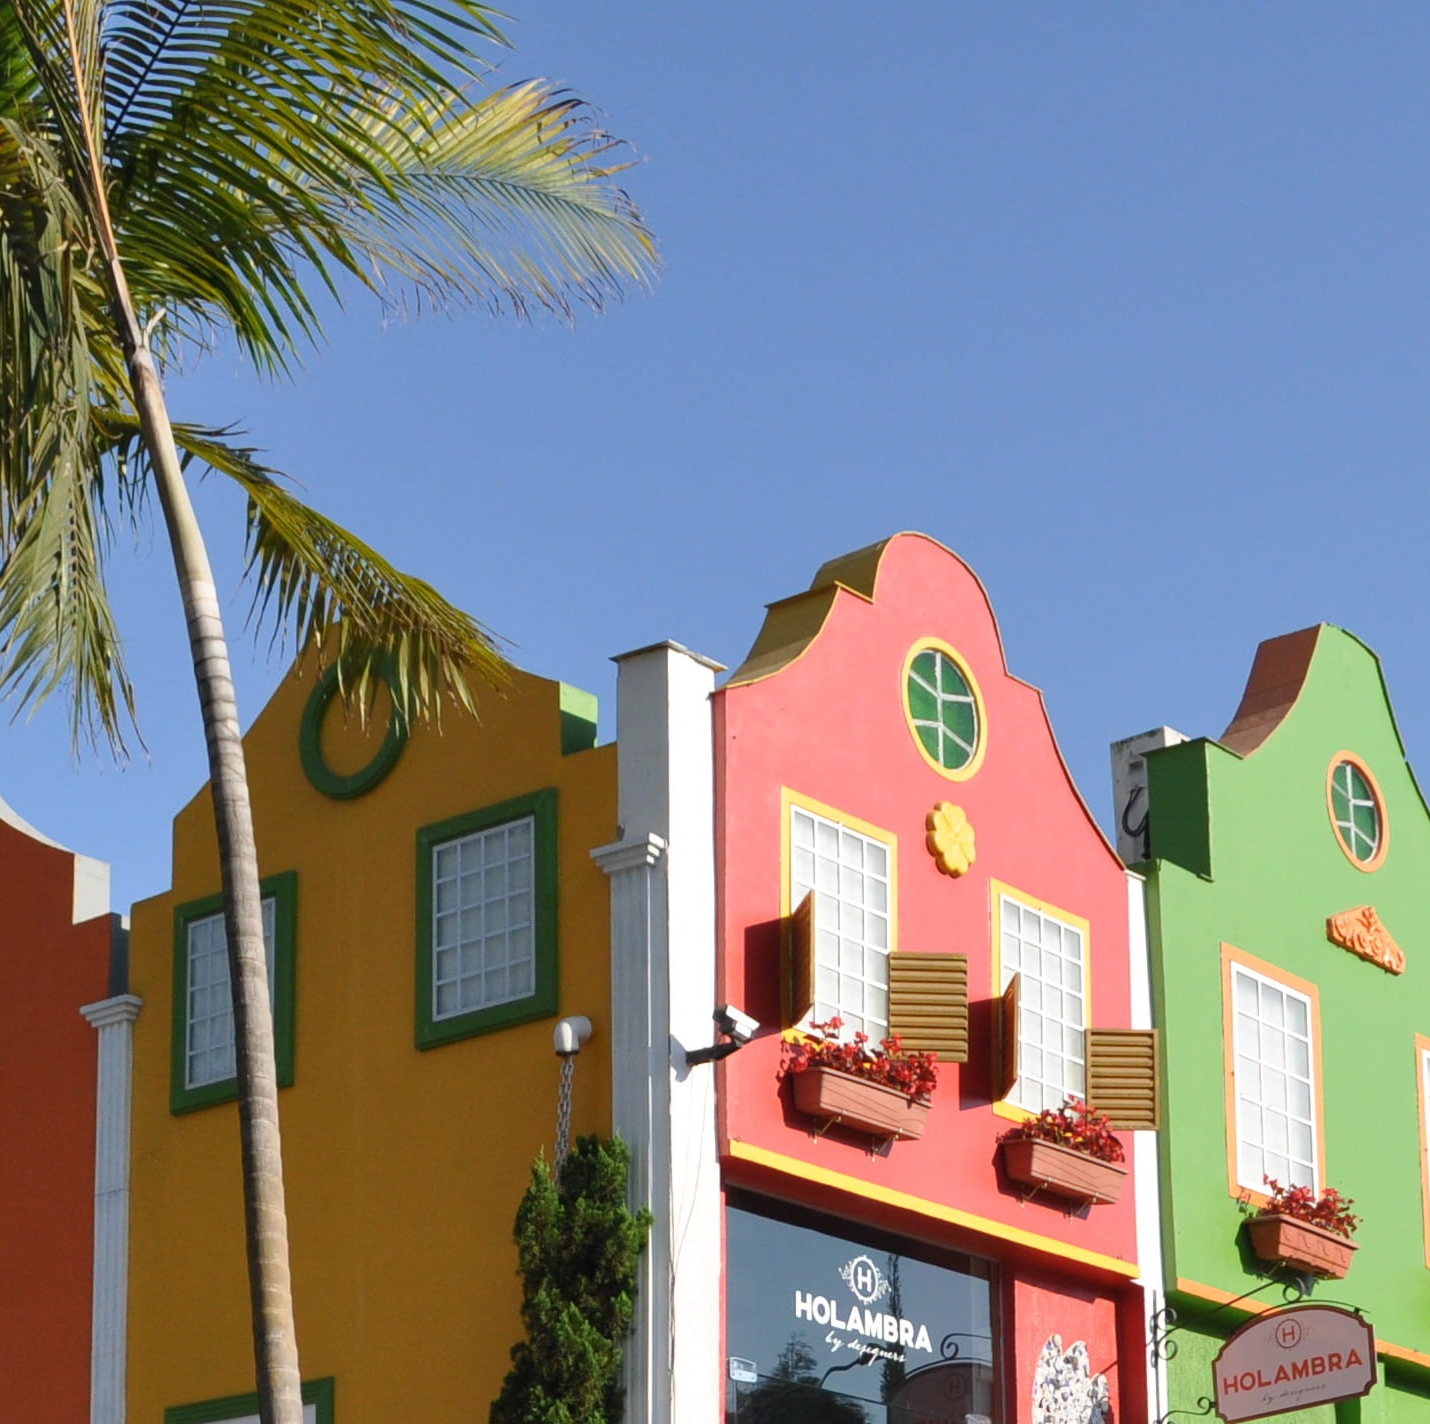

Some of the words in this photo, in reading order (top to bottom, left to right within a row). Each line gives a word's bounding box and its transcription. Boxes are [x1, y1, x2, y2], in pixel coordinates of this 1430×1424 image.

[857, 1266, 872, 1292] H
[795, 1290, 933, 1353] HOLAMBRA
[1282, 1325, 1296, 1342] H
[825, 1330, 844, 1352] by
[1223, 1348, 1363, 1395] HOLAMBRA
